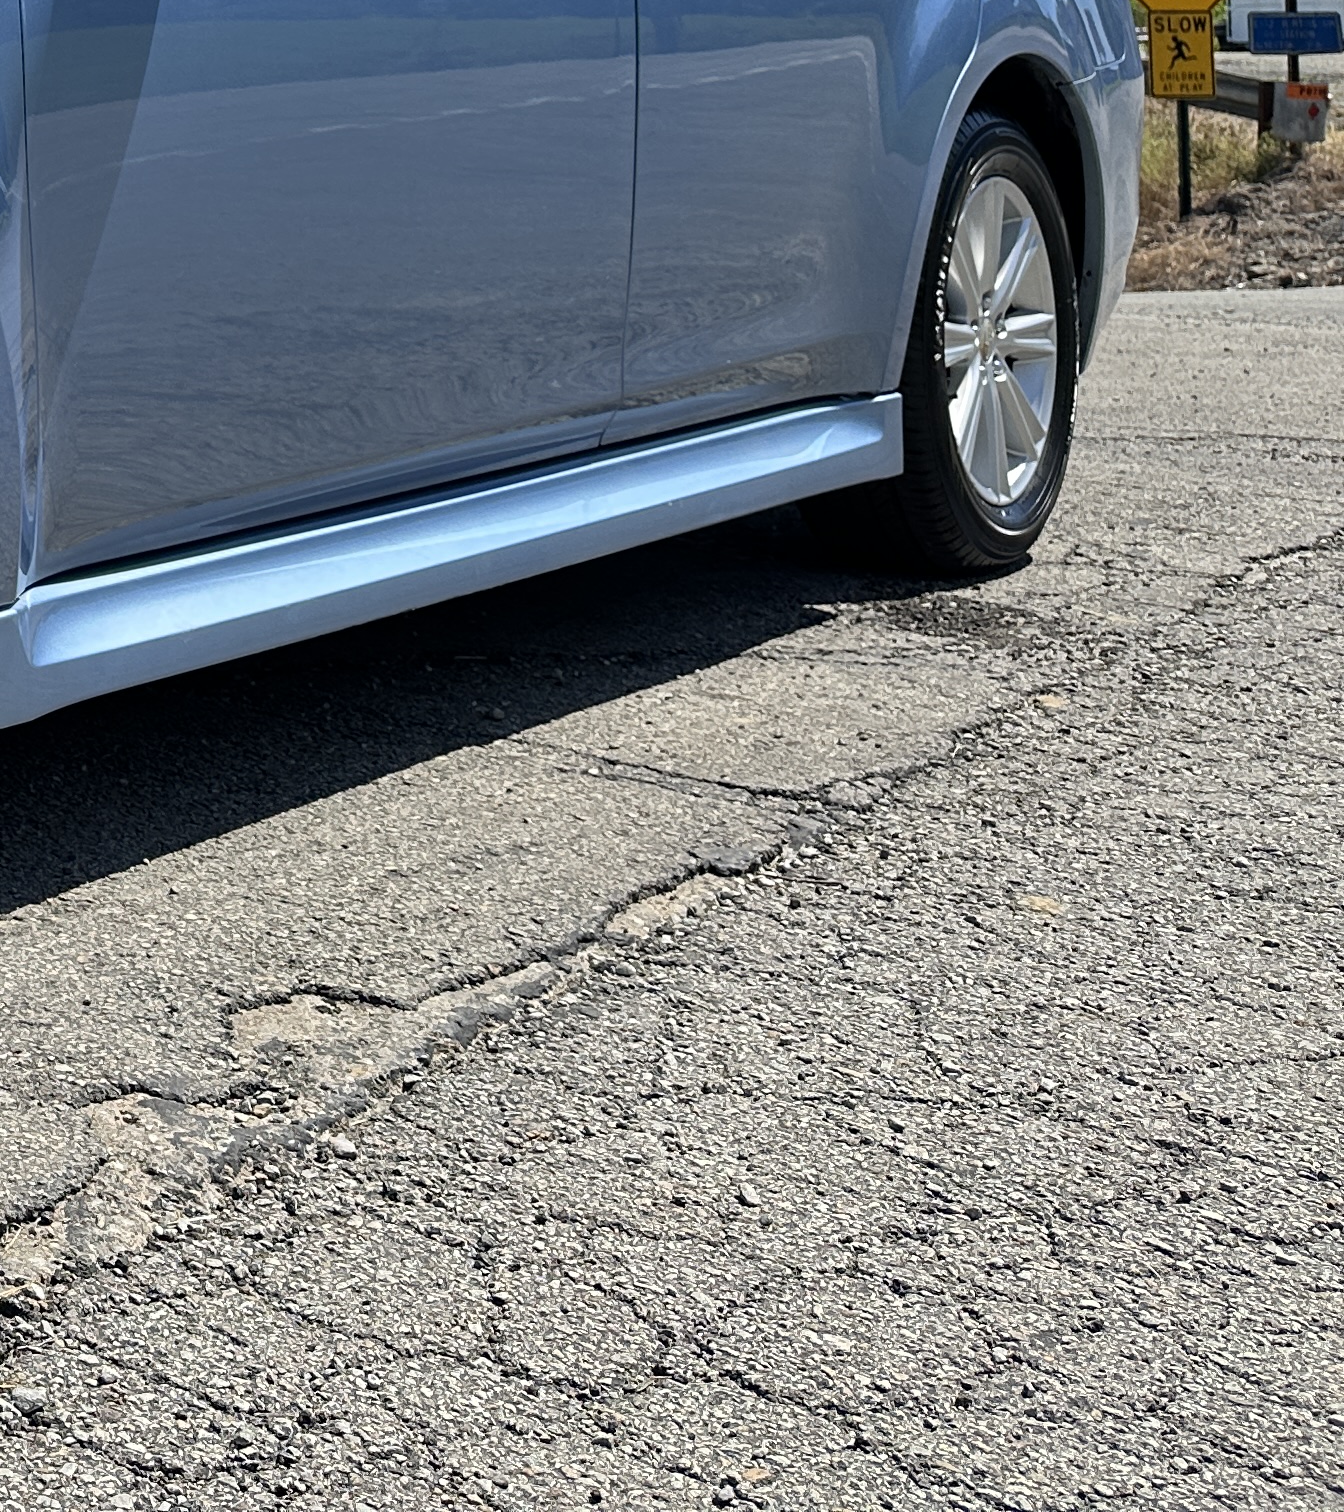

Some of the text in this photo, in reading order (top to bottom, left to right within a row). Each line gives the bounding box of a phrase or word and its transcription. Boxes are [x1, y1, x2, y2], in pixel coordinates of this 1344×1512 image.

[1153, 15, 1207, 34] SLOW
[1159, 71, 1206, 83] CHILDREN
[1163, 82, 1204, 94] AT PLAY
